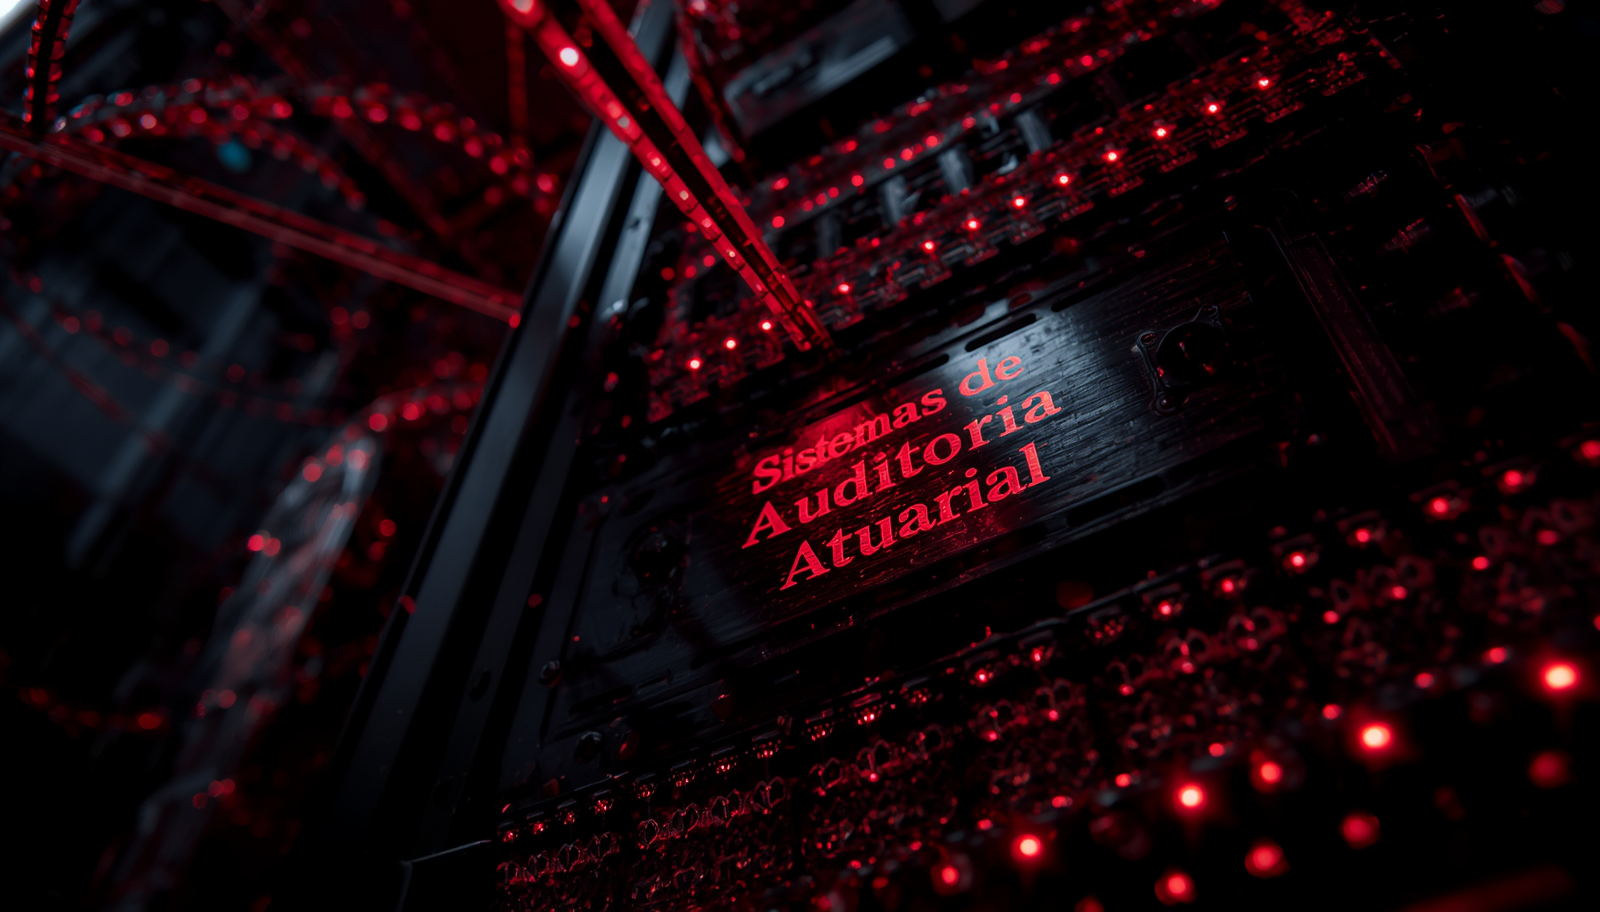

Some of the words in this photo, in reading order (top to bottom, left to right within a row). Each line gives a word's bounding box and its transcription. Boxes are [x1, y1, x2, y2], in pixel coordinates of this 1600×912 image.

[741, 391, 1062, 549] Auditoria
[751, 388, 947, 495] Sistemas
[958, 355, 1024, 397] de
[780, 442, 1050, 591] Atuarial
